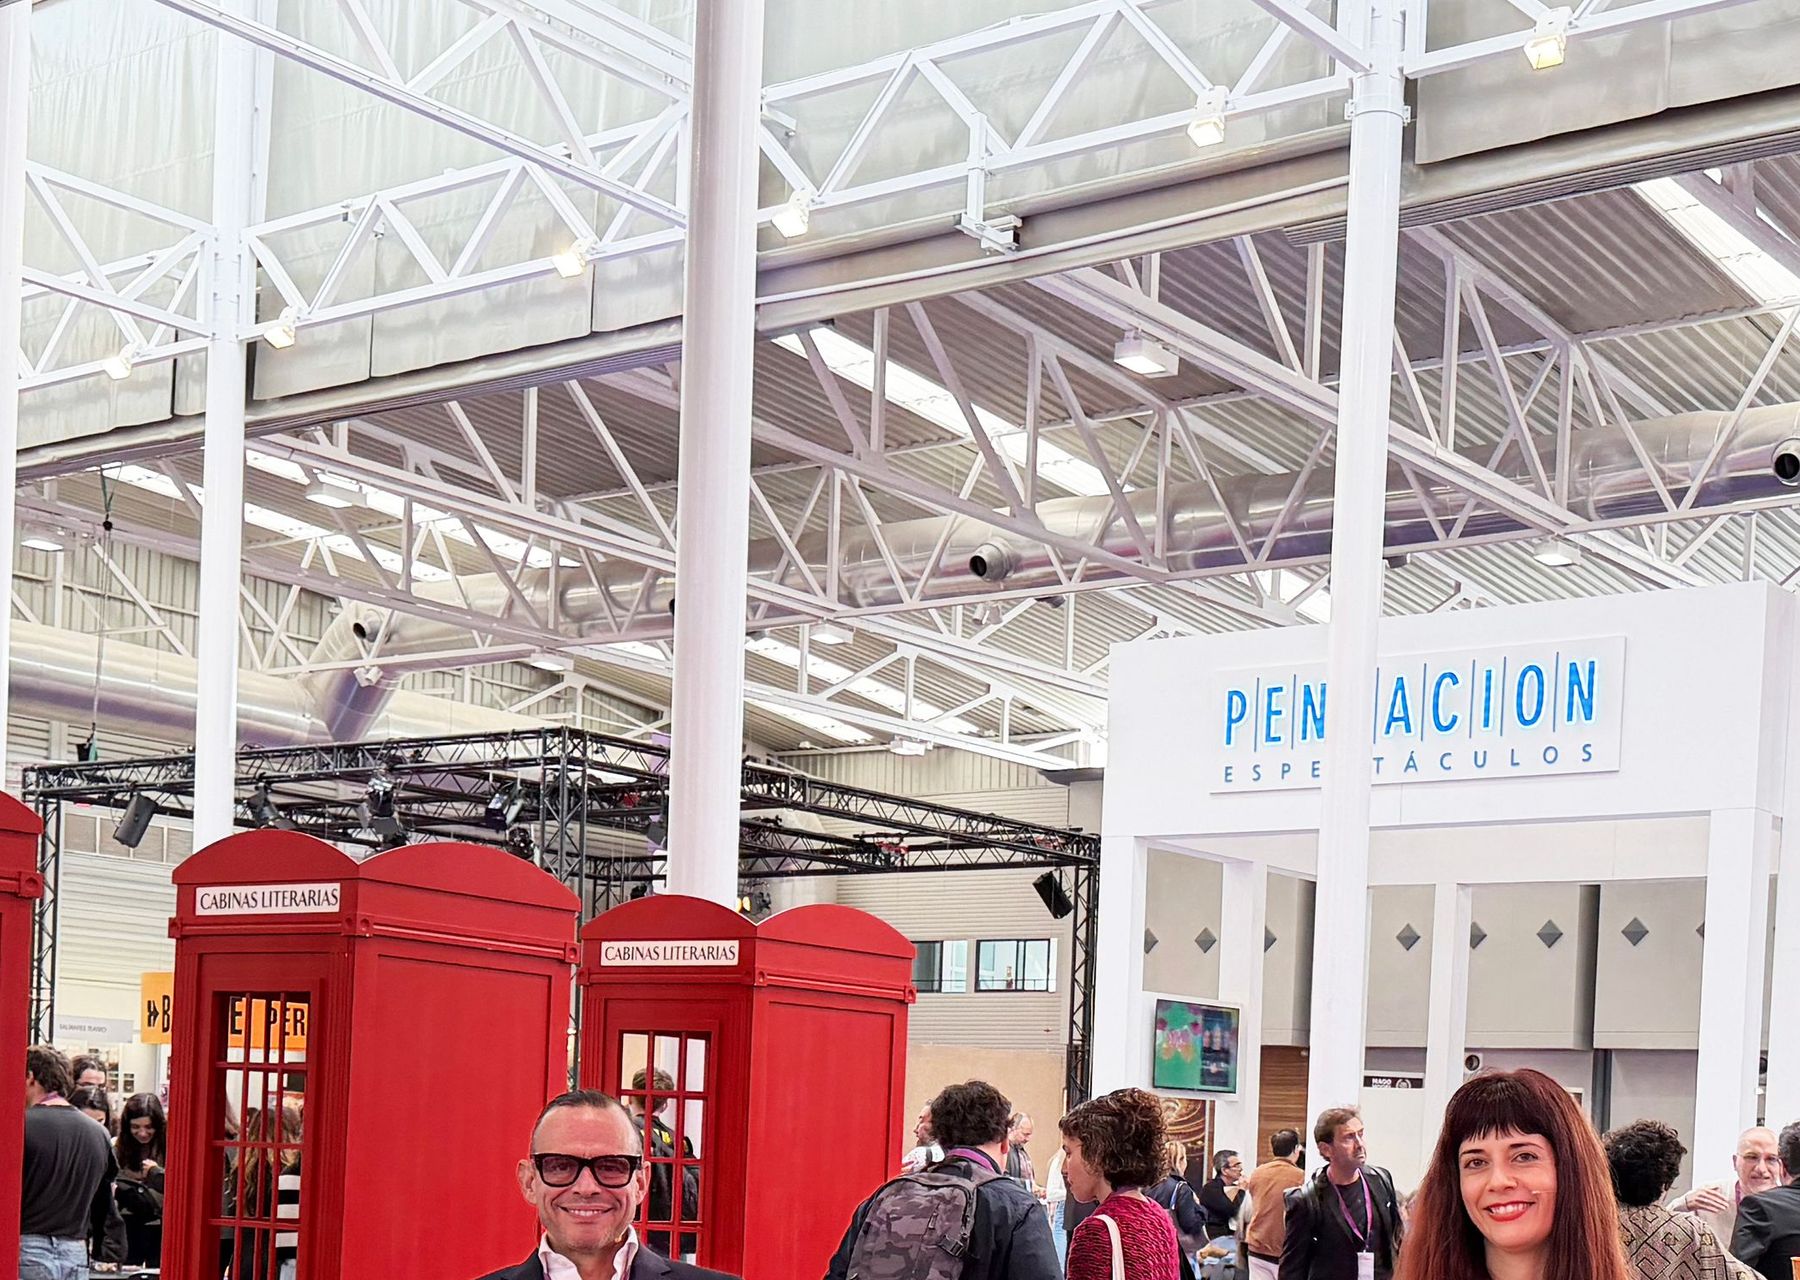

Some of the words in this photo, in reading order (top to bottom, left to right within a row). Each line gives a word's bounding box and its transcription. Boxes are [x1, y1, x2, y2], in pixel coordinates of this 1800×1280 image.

[1225, 661, 1596, 746] PENACION
[1225, 743, 1593, 783] ESPETÁCULOS
[200, 891, 258, 910] CABINAS
[262, 888, 338, 908] LITERARIAS
[605, 946, 660, 961] CABINAS
[663, 945, 736, 961] LITERARIAS
